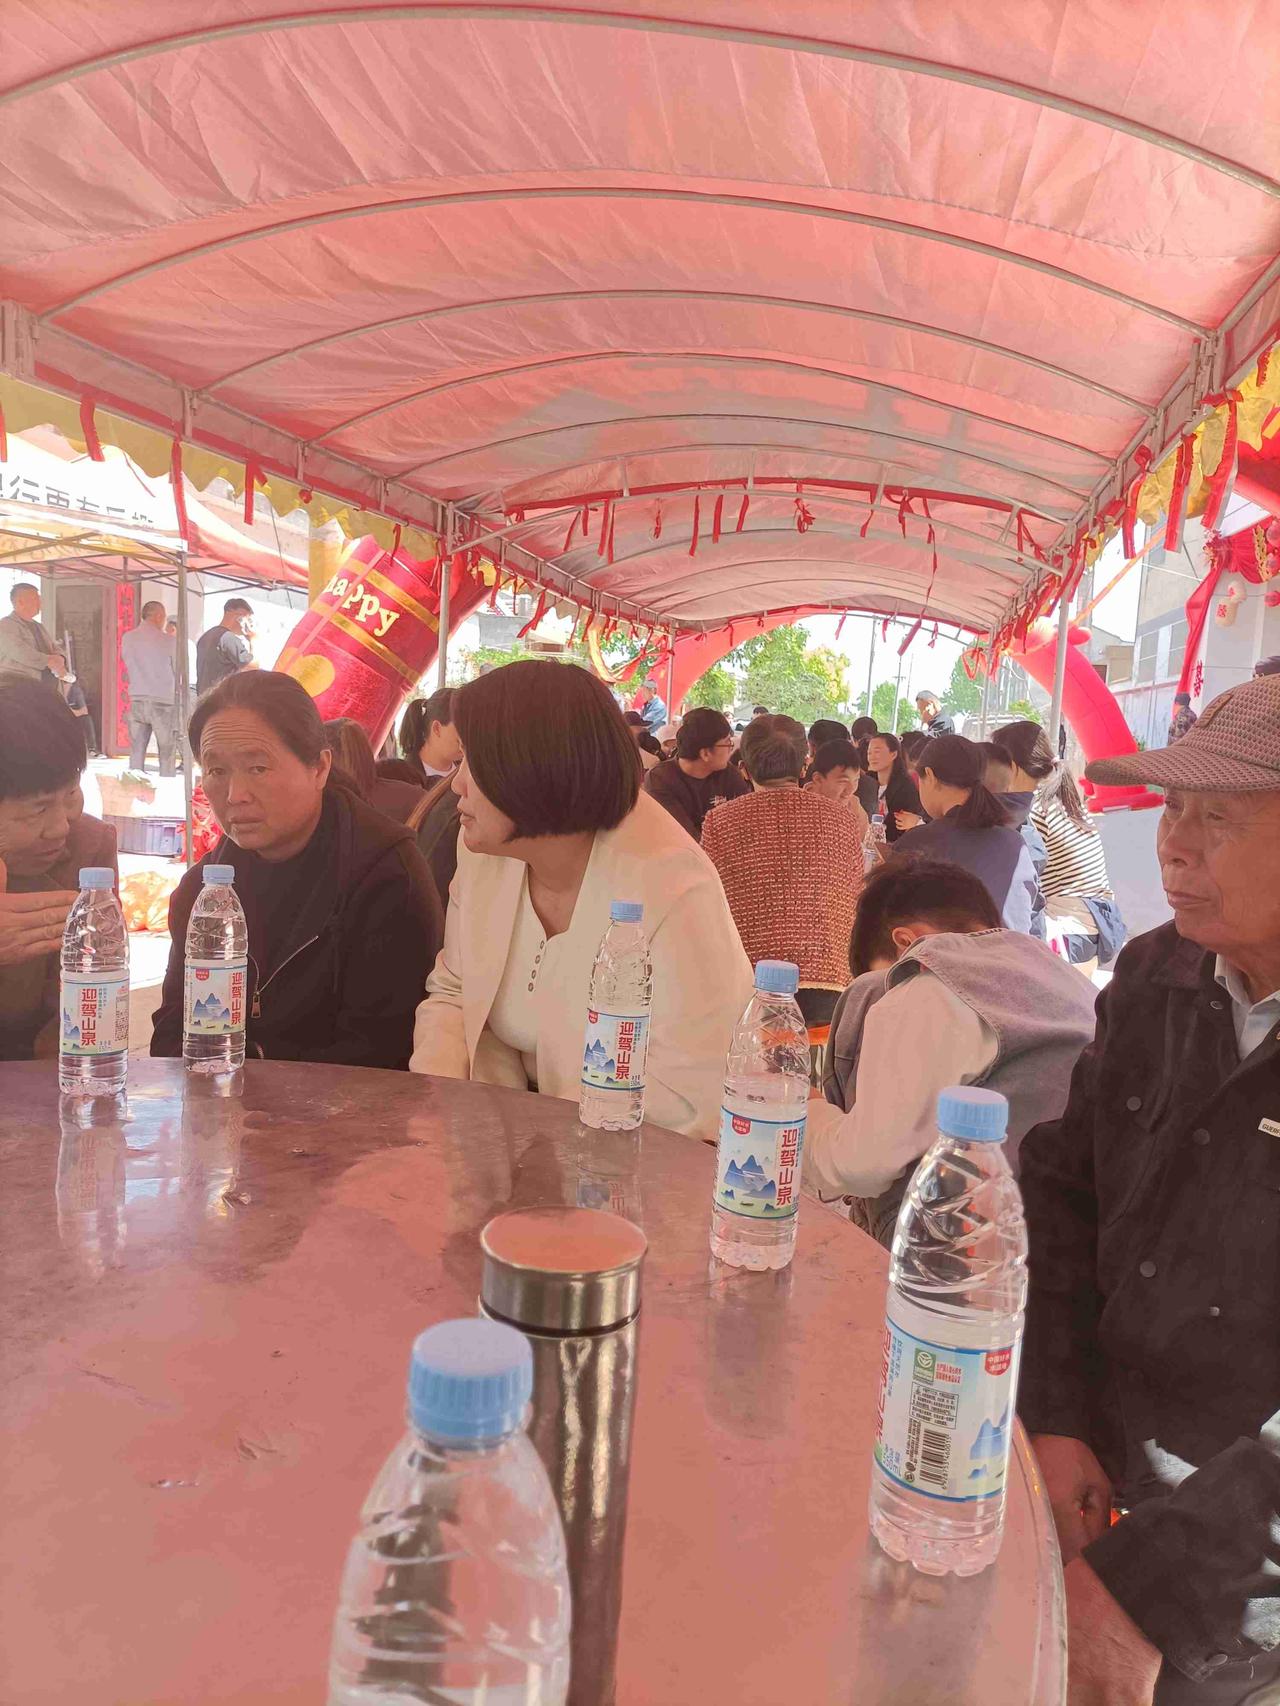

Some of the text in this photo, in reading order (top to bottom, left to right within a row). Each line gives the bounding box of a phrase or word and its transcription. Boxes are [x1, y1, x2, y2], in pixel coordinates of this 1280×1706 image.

[81, 988, 97, 1045] 迎驾山泉
[231, 973, 241, 1024] 迎驾山泉
[616, 1021, 634, 1079] 迎驾山泉
[776, 1128, 798, 1206] 迎驾山泉
